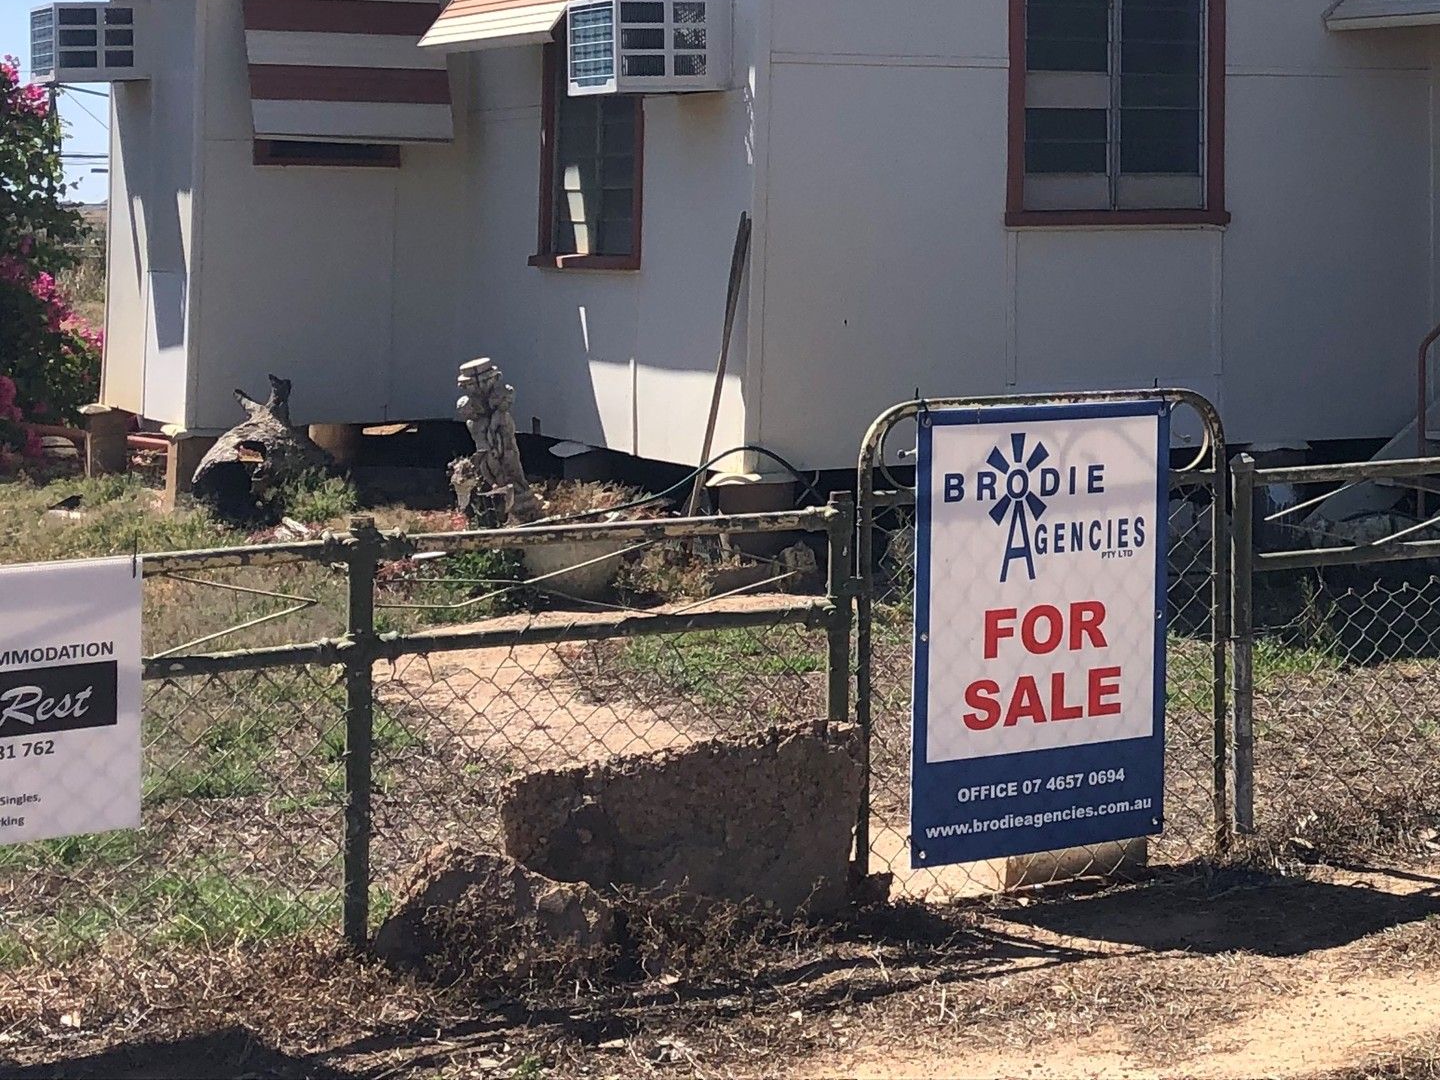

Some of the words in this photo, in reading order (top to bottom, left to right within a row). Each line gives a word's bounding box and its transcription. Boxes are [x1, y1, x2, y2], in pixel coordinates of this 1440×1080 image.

[943, 464, 1105, 503] BRODIE
[999, 500, 1145, 583] AGENCIES
[1101, 551, 1116, 559] PTY
[1118, 549, 1133, 558] LTD
[983, 600, 1108, 660] FOR
[963, 666, 1122, 731] SALE
[22, 739, 55, 757] 762
[0, 793, 42, 806] Singles,
[957, 781, 1018, 803] OFFICE
[1022, 778, 1043, 795] 07
[1045, 773, 1085, 792] 4657
[1088, 767, 1125, 786] 0694
[925, 797, 1152, 839] www.brodieagencies.com.au
